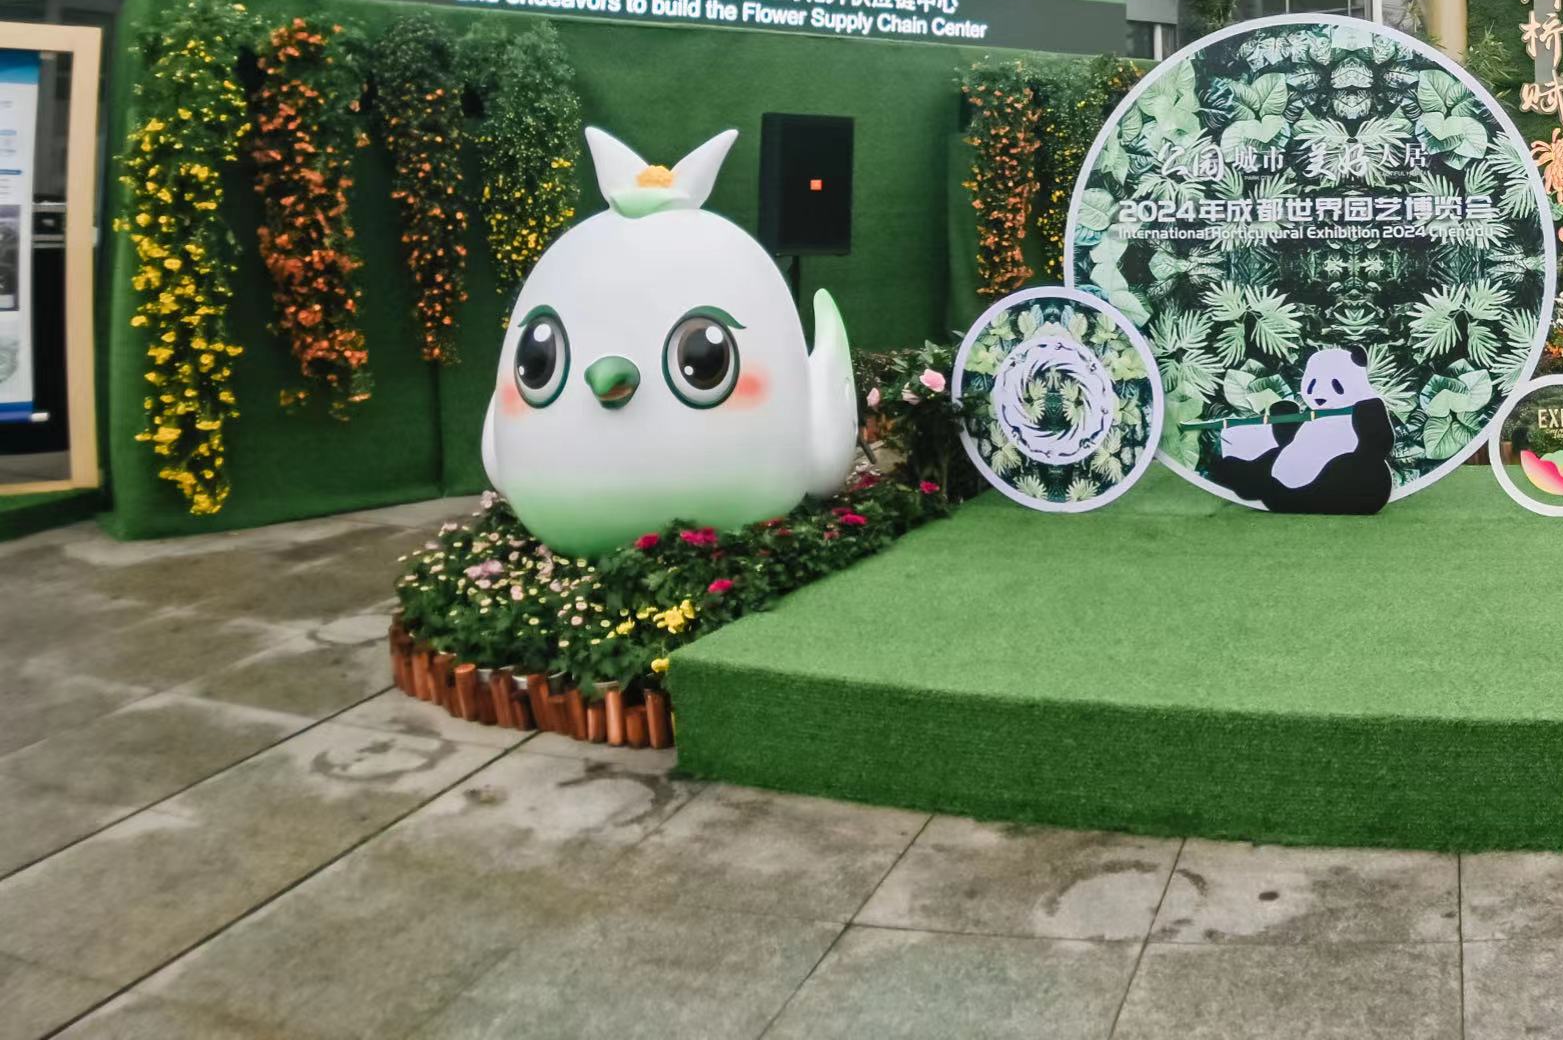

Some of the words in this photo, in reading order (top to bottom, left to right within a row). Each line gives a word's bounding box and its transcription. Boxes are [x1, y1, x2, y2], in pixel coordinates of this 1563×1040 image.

[705, 0, 738, 22] the
[742, 2, 808, 27] Flower
[810, 8, 874, 36] Supply
[876, 13, 928, 35] Chain
[931, 19, 988, 40] Center
[1157, 143, 1286, 182] 公园城市
[1302, 141, 1429, 180] 美好人居
[1118, 196, 1495, 223] 2024年成都世界园艺博览会
[1118, 226, 1209, 240] International
[1211, 226, 1303, 240] Horticultural
[1306, 225, 1380, 239] Exhibition
[1382, 225, 1427, 238] 2024
[1429, 225, 1494, 240] Chengdu
